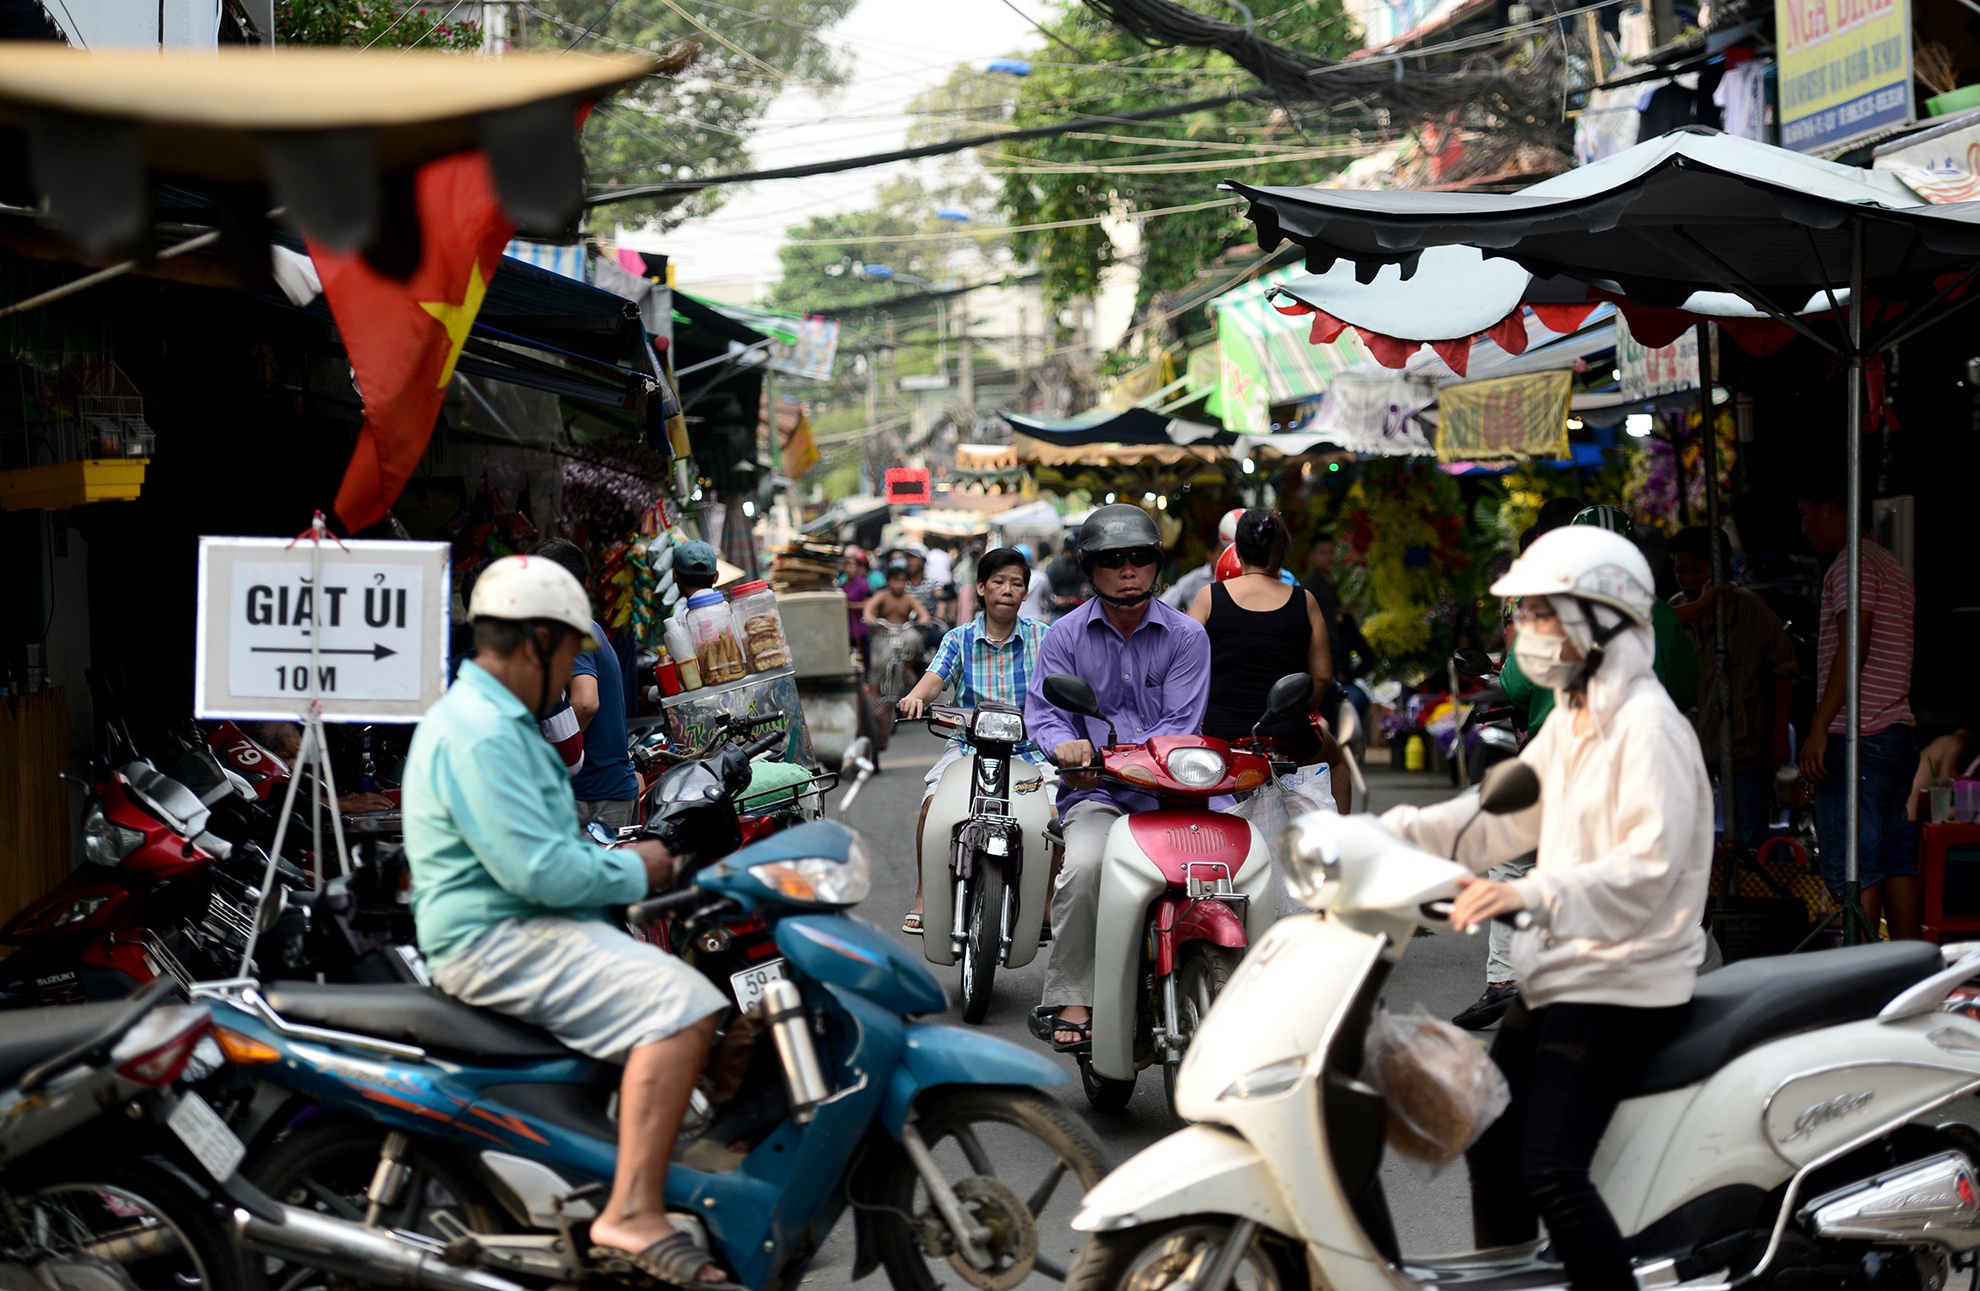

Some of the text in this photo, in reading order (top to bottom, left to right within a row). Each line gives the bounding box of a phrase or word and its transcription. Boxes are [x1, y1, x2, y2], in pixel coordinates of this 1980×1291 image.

[246, 573, 407, 637] GIẶT ỦI
[275, 665, 337, 692] 10M
[228, 739, 263, 765] 79
[36, 971, 76, 986] SUZUKI
